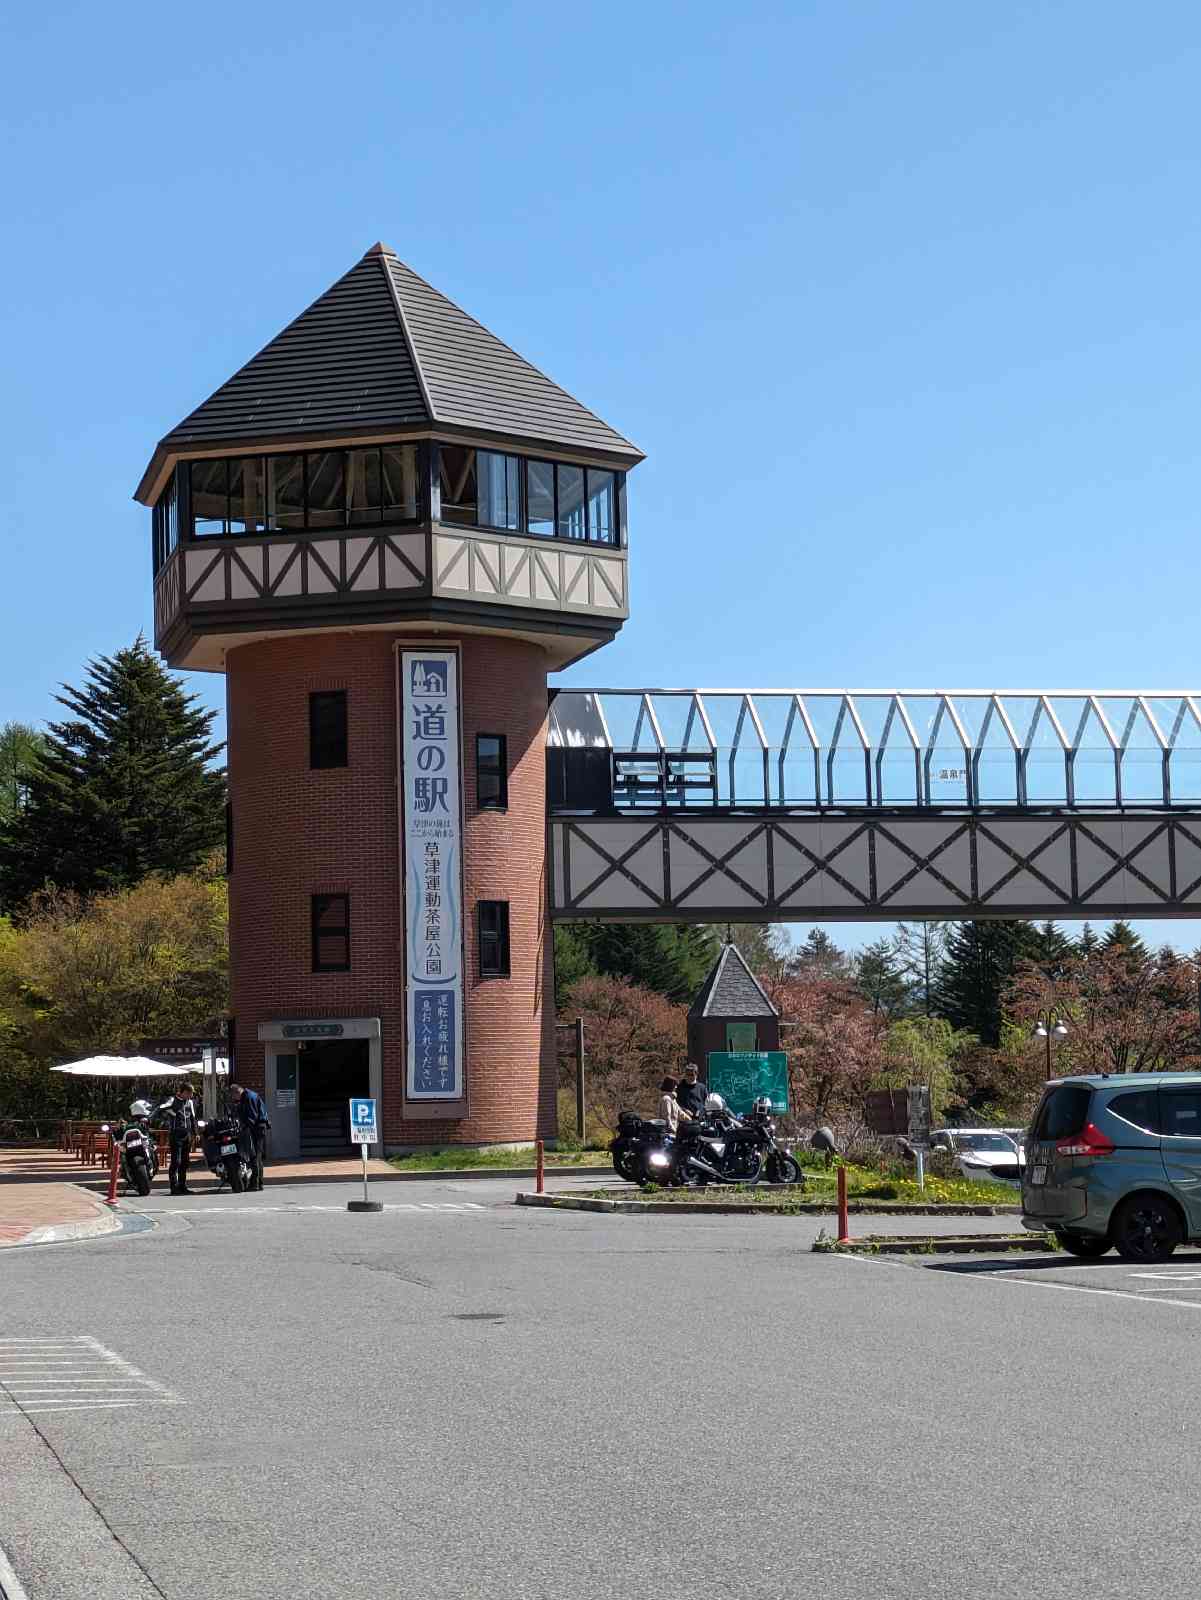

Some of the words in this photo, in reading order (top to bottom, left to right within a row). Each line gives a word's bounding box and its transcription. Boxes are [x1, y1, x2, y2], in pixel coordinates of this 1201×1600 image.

[412, 703, 449, 812] 道の駅
[424, 841, 441, 975] 草津運動茶屋公園
[420, 995, 433, 1089] 一息お入れください
[357, 1103, 369, 1123] P
